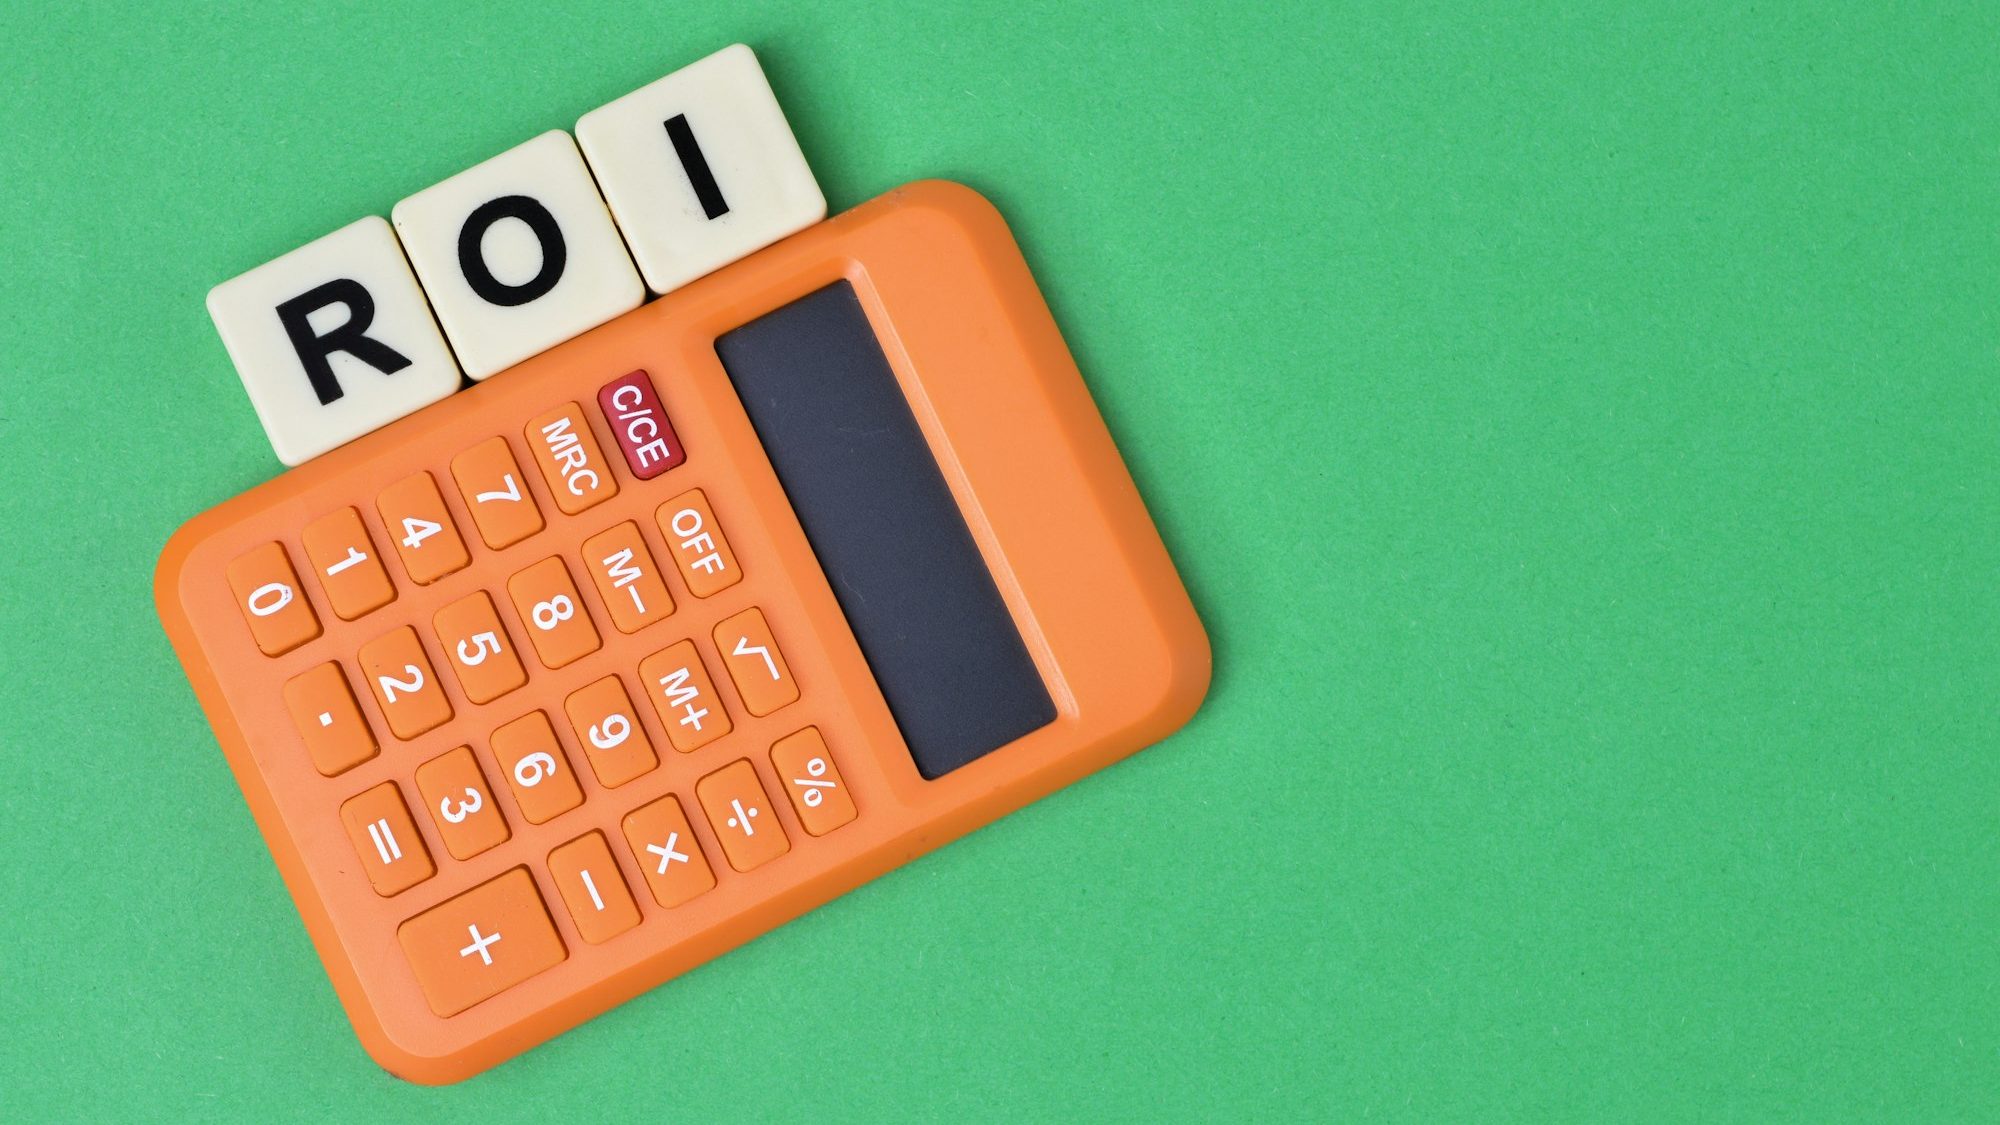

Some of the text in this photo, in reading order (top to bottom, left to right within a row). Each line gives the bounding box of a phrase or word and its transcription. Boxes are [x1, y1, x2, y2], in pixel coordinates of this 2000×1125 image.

[612, 385, 670, 468] C/CE
[542, 417, 599, 496] MRC
[476, 474, 521, 503] 7
[402, 517, 442, 548] 4
[672, 509, 725, 574] OFF
[326, 547, 367, 576] 1
[248, 583, 293, 616] 0
[532, 594, 574, 631] 8
[457, 632, 501, 666] 5
[378, 665, 424, 703] 2
[659, 668, 708, 731] M+
[589, 714, 631, 749] 9
[514, 752, 556, 788] 6
[794, 758, 836, 807] %
[440, 787, 483, 823] 3
